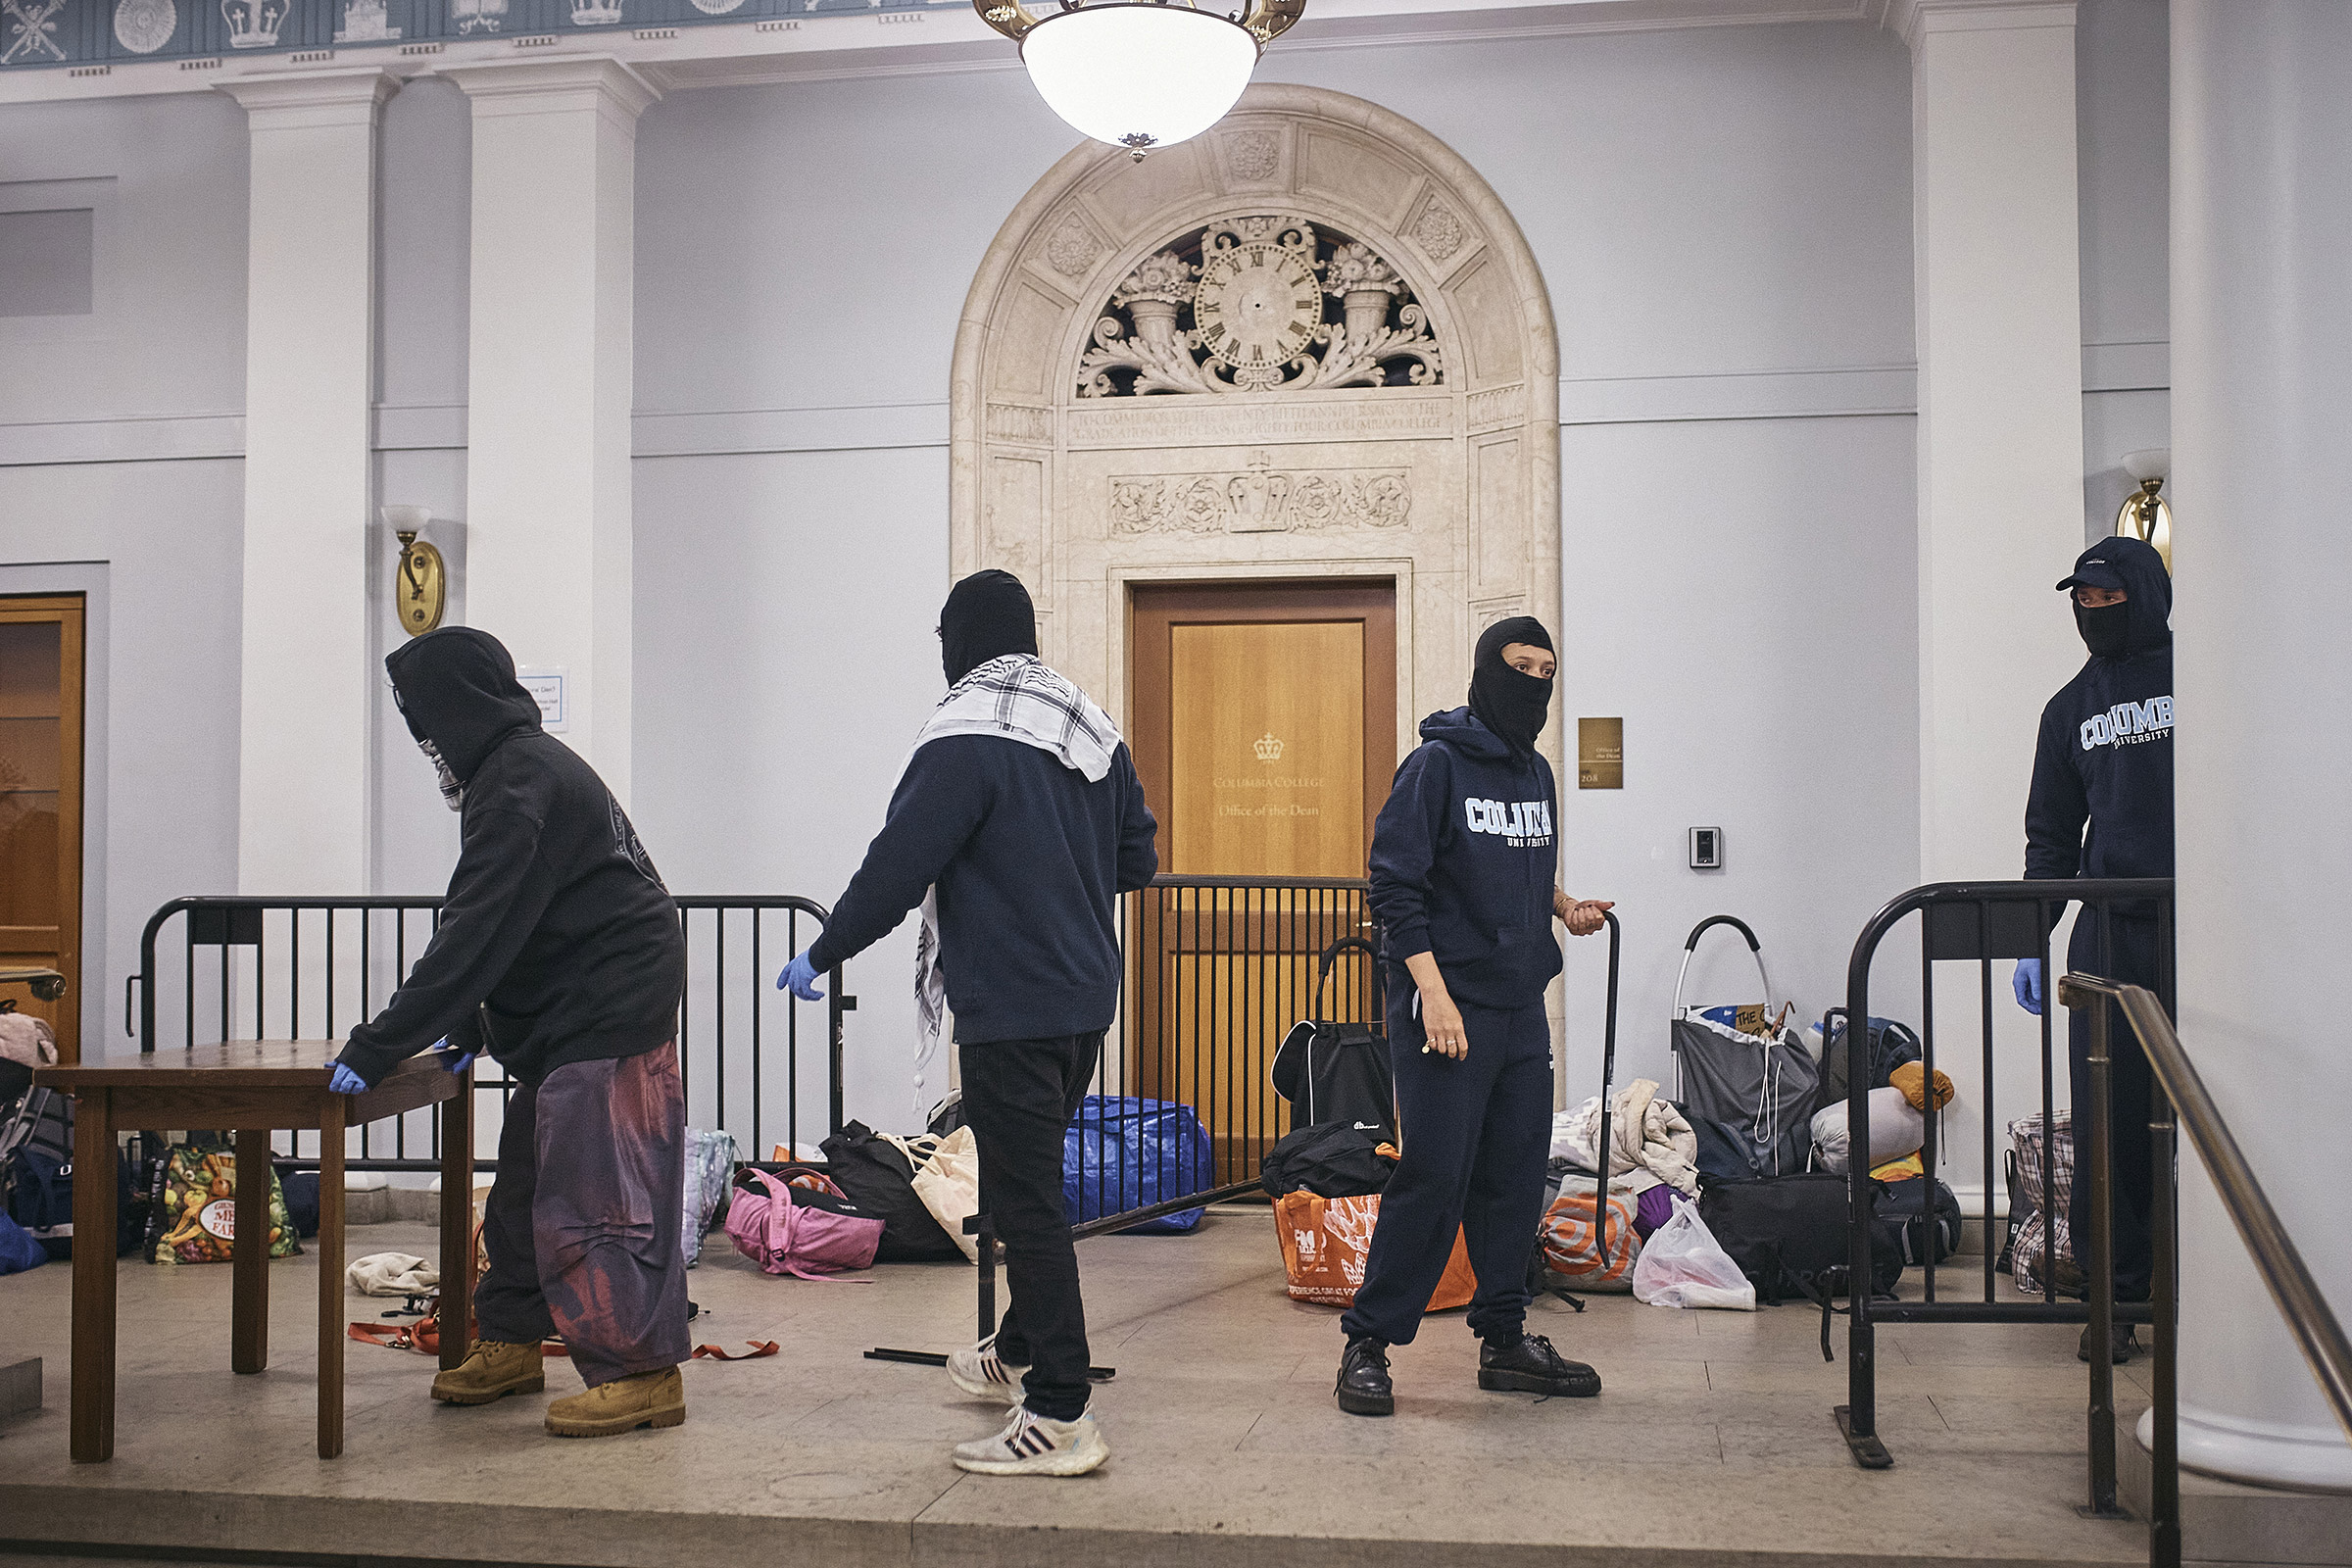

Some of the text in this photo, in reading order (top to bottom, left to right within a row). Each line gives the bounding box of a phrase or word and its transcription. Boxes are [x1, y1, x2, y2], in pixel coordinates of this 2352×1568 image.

[1250, 251, 1263, 268] XII
[1276, 258, 1286, 272] I
[1209, 277, 1226, 290] X
[1290, 275, 1306, 288] II
[1203, 302, 1220, 313] IX
[1252, 345, 1263, 361] VI
[1276, 339, 1289, 355] V
[2080, 695, 2174, 751] COLUMB
[2114, 728, 2170, 750] NIVERSITY
[1212, 776, 1326, 788] COLUMBIA COLLEGE
[1218, 805, 1319, 816] Office of the Dean
[1736, 1010, 1756, 1026] THE
[213, 1222, 234, 1236] FAR
